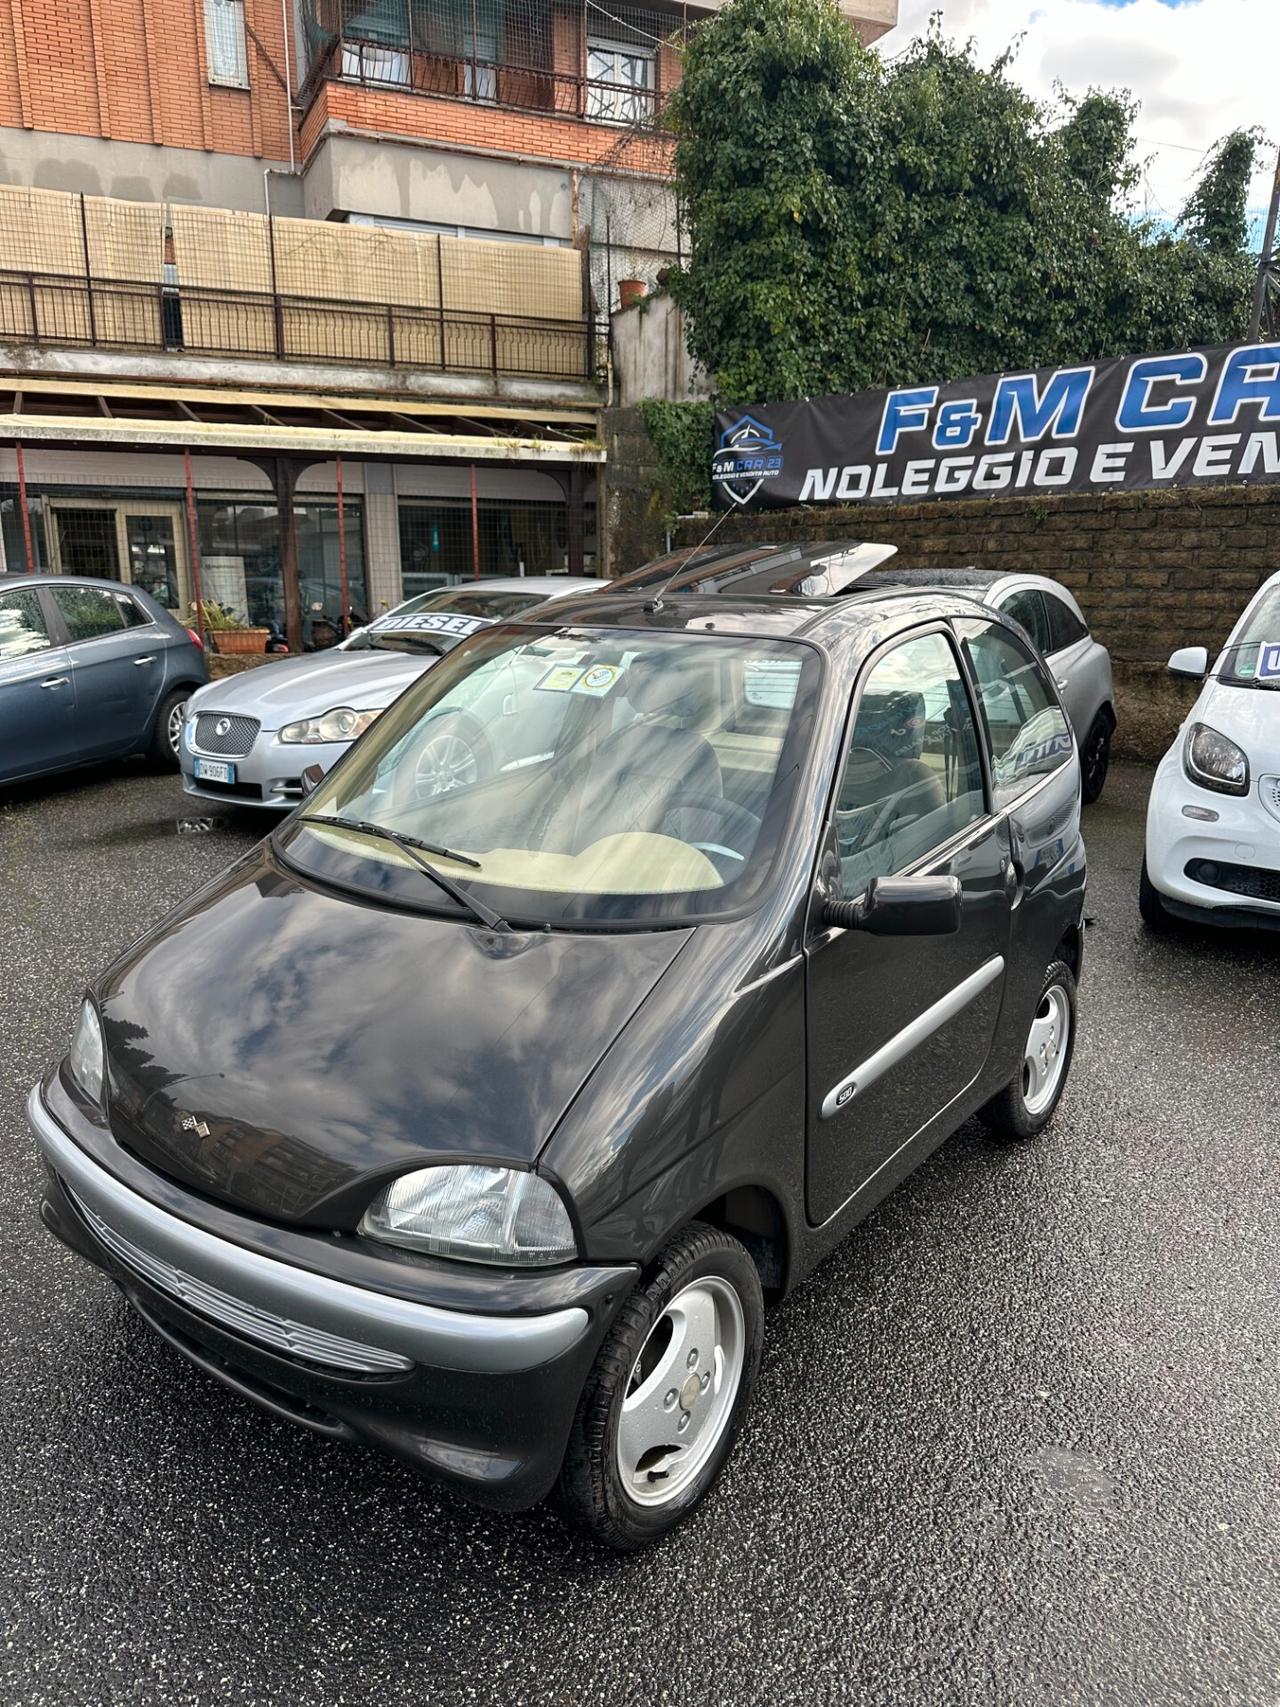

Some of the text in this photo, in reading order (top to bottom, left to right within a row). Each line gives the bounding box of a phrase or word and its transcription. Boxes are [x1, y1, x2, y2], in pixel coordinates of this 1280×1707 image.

[875, 366, 1096, 455] F&M
[736, 460, 764, 471] CAR
[767, 458, 781, 469] 23
[1089, 442, 1135, 483] E
[373, 615, 482, 635] DIESEL
